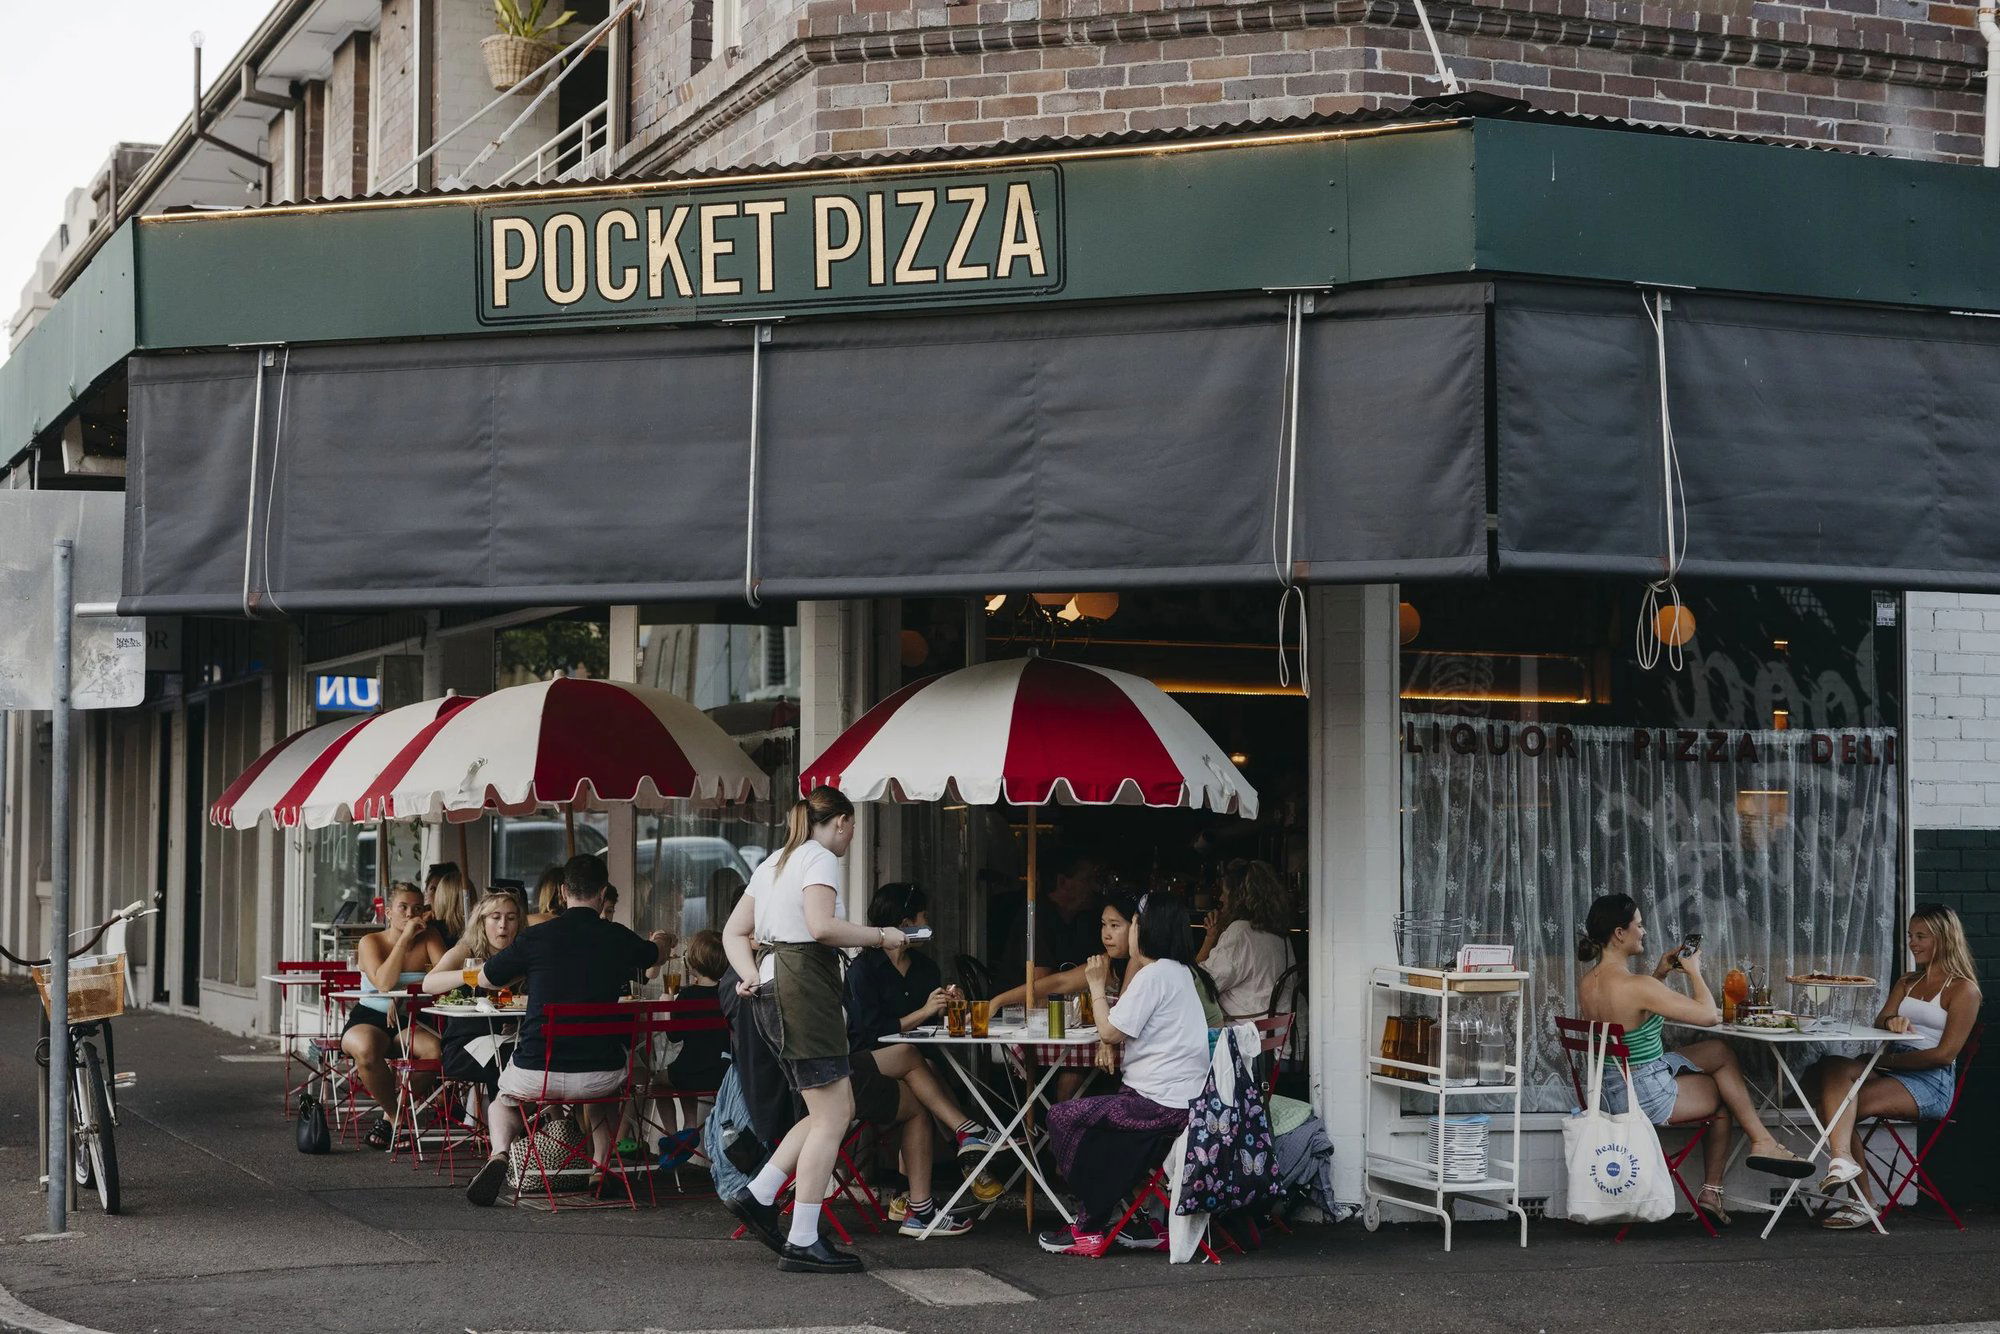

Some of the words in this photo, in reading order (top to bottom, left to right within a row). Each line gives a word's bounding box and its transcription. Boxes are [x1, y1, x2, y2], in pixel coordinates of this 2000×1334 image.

[490, 197, 788, 309] POCKET
[813, 181, 1047, 291] PIZZA
[1407, 721, 1579, 759] LIQUOR
[1633, 729, 1760, 764] PIZZA
[1811, 734, 1896, 765] DELI
[1628, 1154, 1640, 1178] skin
[1624, 1179, 1636, 1189] is
